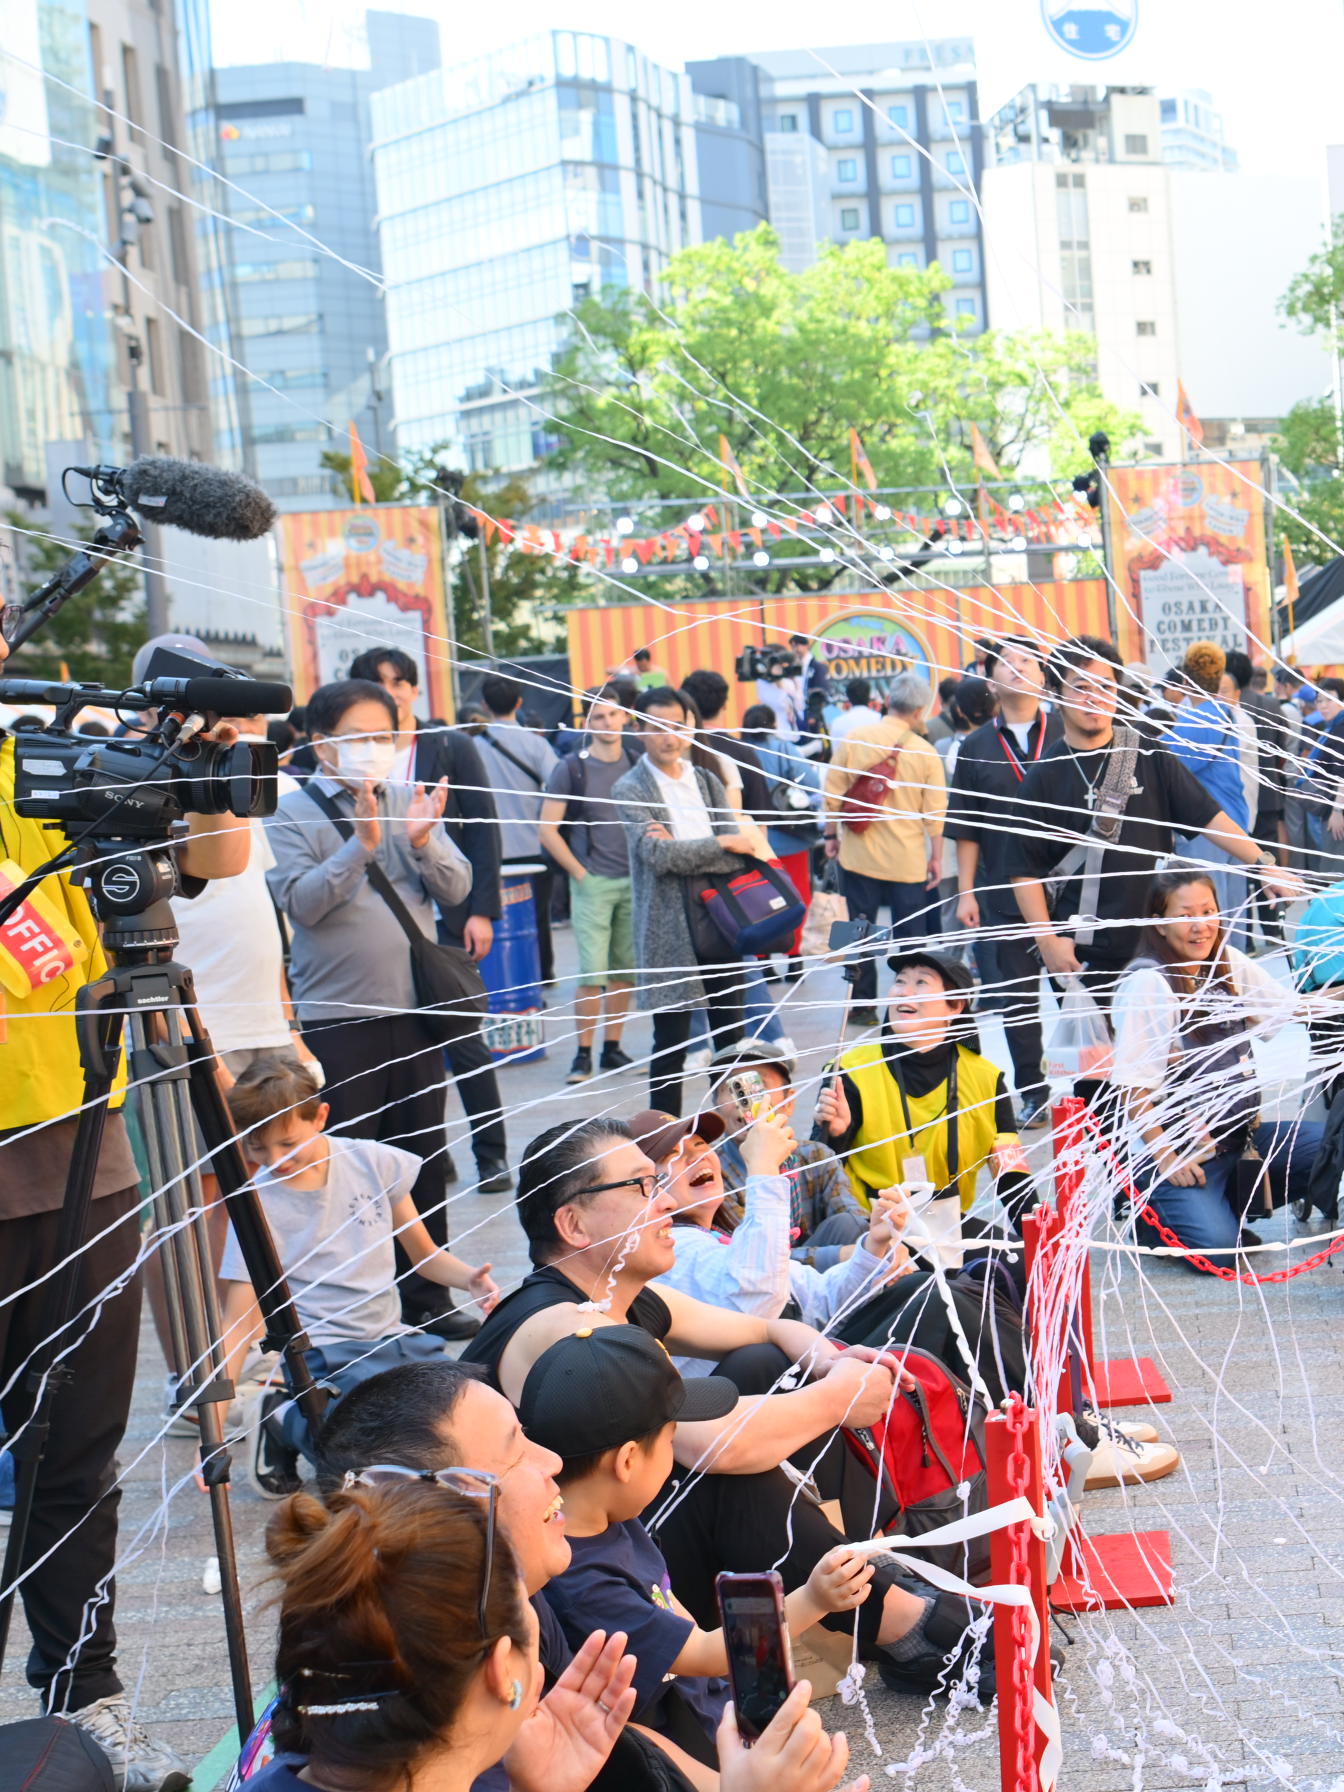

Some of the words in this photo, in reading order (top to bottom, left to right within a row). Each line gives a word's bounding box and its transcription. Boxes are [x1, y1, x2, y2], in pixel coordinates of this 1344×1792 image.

[1162, 599, 1223, 616] OSAKA
[1157, 616, 1229, 635] COMEDY
[821, 634, 909, 659] OSAKA
[1149, 634, 1242, 653] FESTAL
[826, 656, 914, 680] OMEDY
[104, 790, 145, 809] SONY
